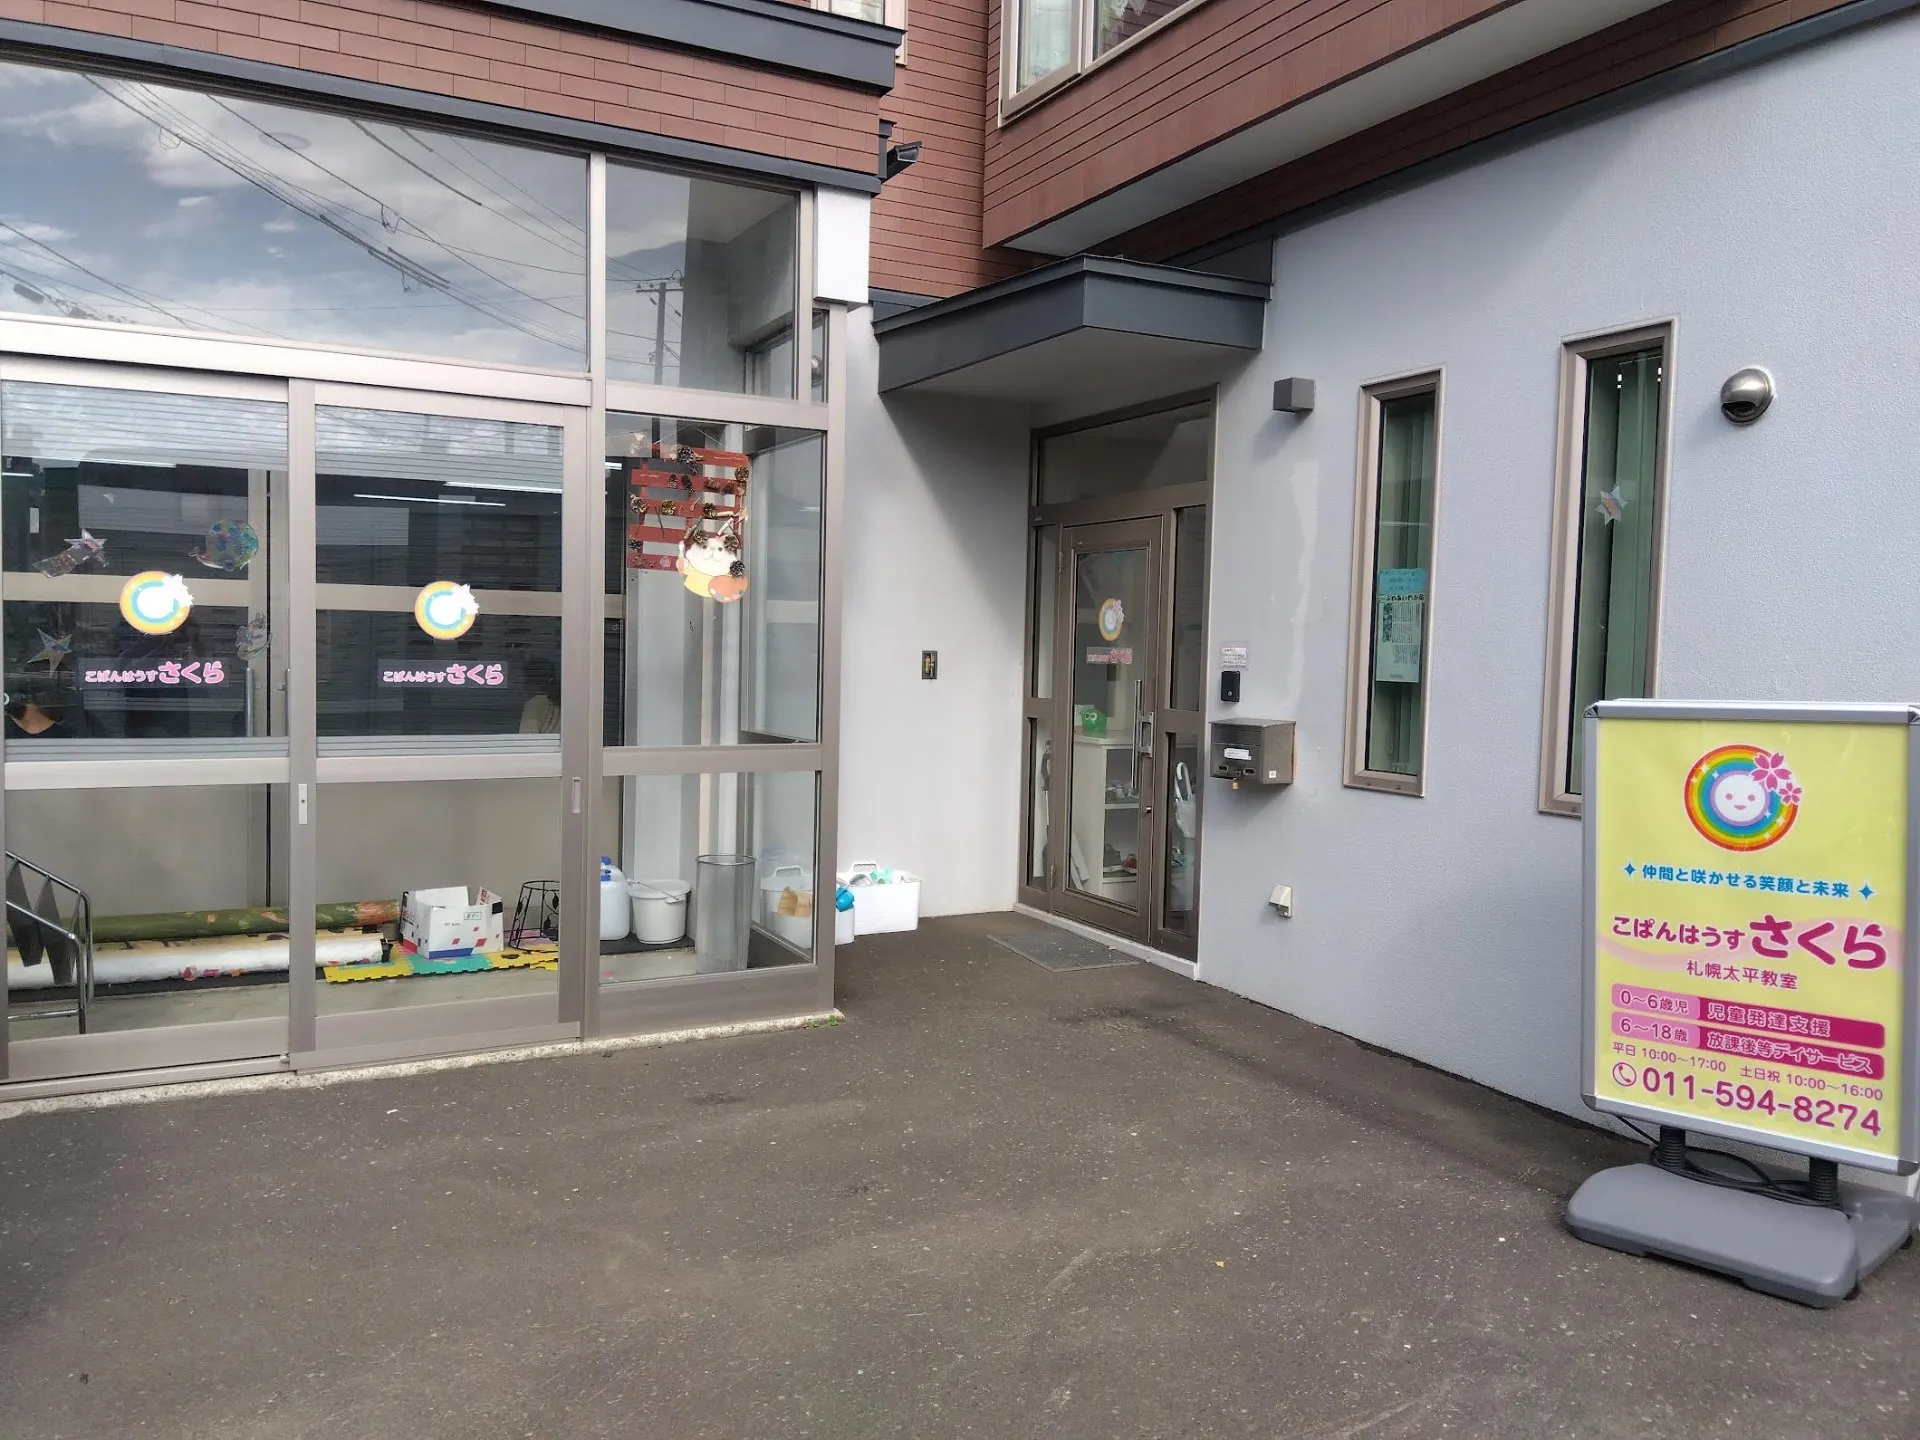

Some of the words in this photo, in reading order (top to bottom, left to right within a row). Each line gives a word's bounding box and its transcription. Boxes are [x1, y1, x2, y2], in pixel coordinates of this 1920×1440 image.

[1642, 864, 1850, 898] 仲間と咲かせる笑顔と未来
[1686, 960, 1798, 990] 札幌太平教室
[1708, 1002, 1831, 1037] 児童発達支援
[1612, 1041, 1637, 1056] 平日
[1740, 1065, 1781, 1083] 土日祝
[1707, 1031, 1873, 1074] 放課後等デイサービス
[1642, 1066, 1882, 1137] 011-594-8274
